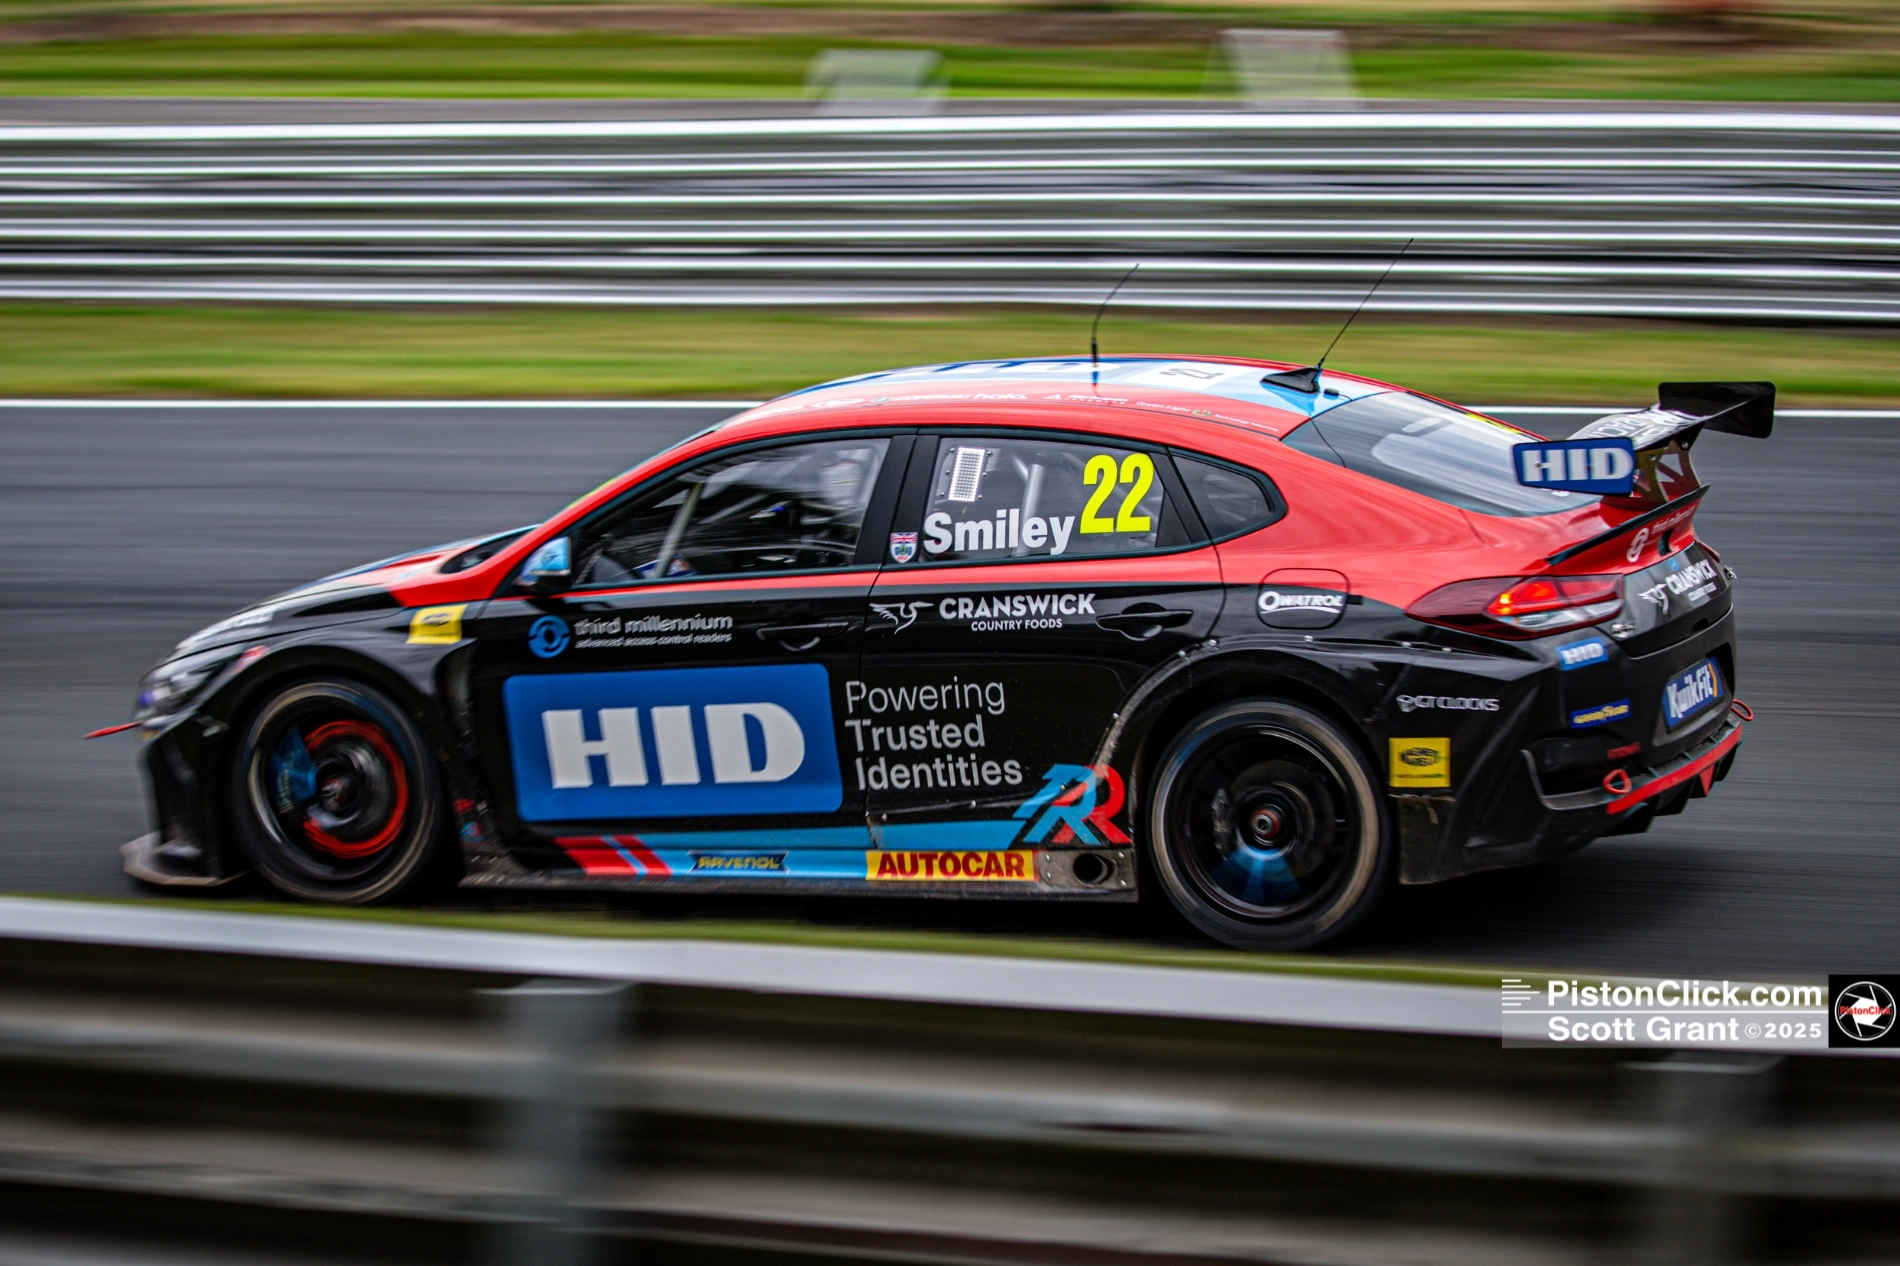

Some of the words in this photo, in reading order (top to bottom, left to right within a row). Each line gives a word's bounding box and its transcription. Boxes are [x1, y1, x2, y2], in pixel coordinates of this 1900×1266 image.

[1521, 447, 1634, 483] HID
[1079, 453, 1154, 534] 22
[923, 508, 1076, 556] Smiley
[1665, 559, 1717, 595] CRANSWICK
[573, 617, 621, 636] third
[624, 613, 733, 634] millennium
[939, 593, 1096, 620] CRANSWICK
[971, 619, 1024, 632] COUNTRY
[1024, 618, 1062, 630] FOODS
[1560, 643, 1605, 665] HID
[845, 675, 1006, 715] Powering
[541, 702, 805, 789] HID
[844, 713, 986, 752] Trusted
[855, 753, 1023, 790] Identities
[698, 855, 781, 870] RAVENOL
[876, 851, 1027, 878] AUTOCAR
